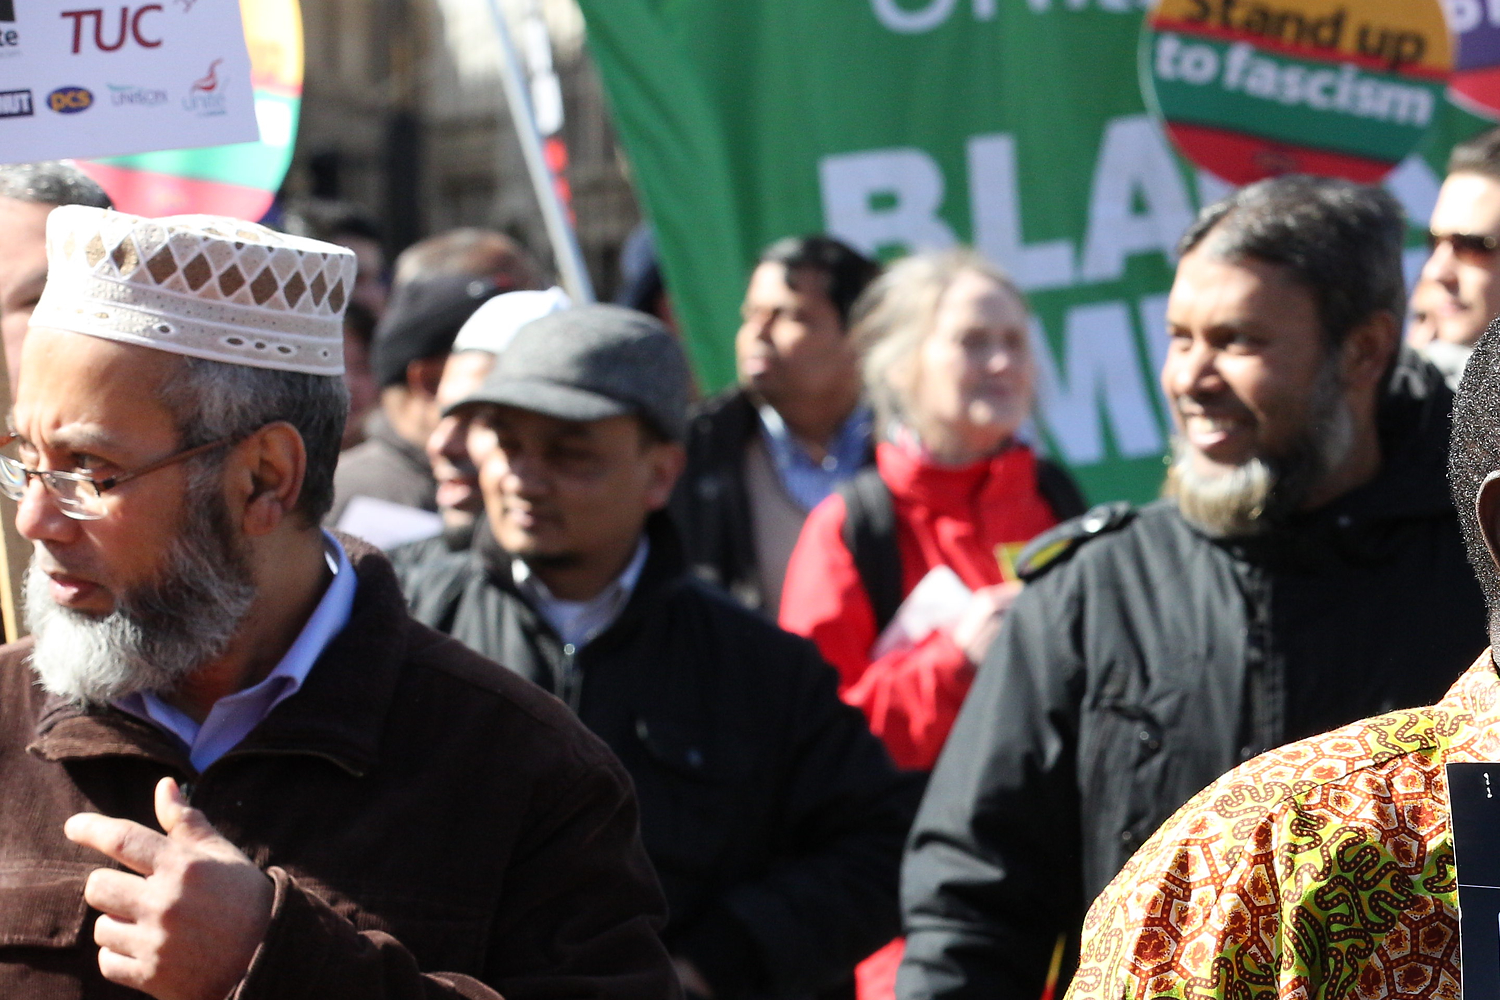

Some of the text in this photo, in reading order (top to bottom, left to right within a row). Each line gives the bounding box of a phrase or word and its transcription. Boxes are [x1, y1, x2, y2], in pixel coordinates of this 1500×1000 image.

[60, 4, 164, 55] TUC
[1358, 22, 1427, 68] up
[1155, 32, 1435, 127] to fascism
